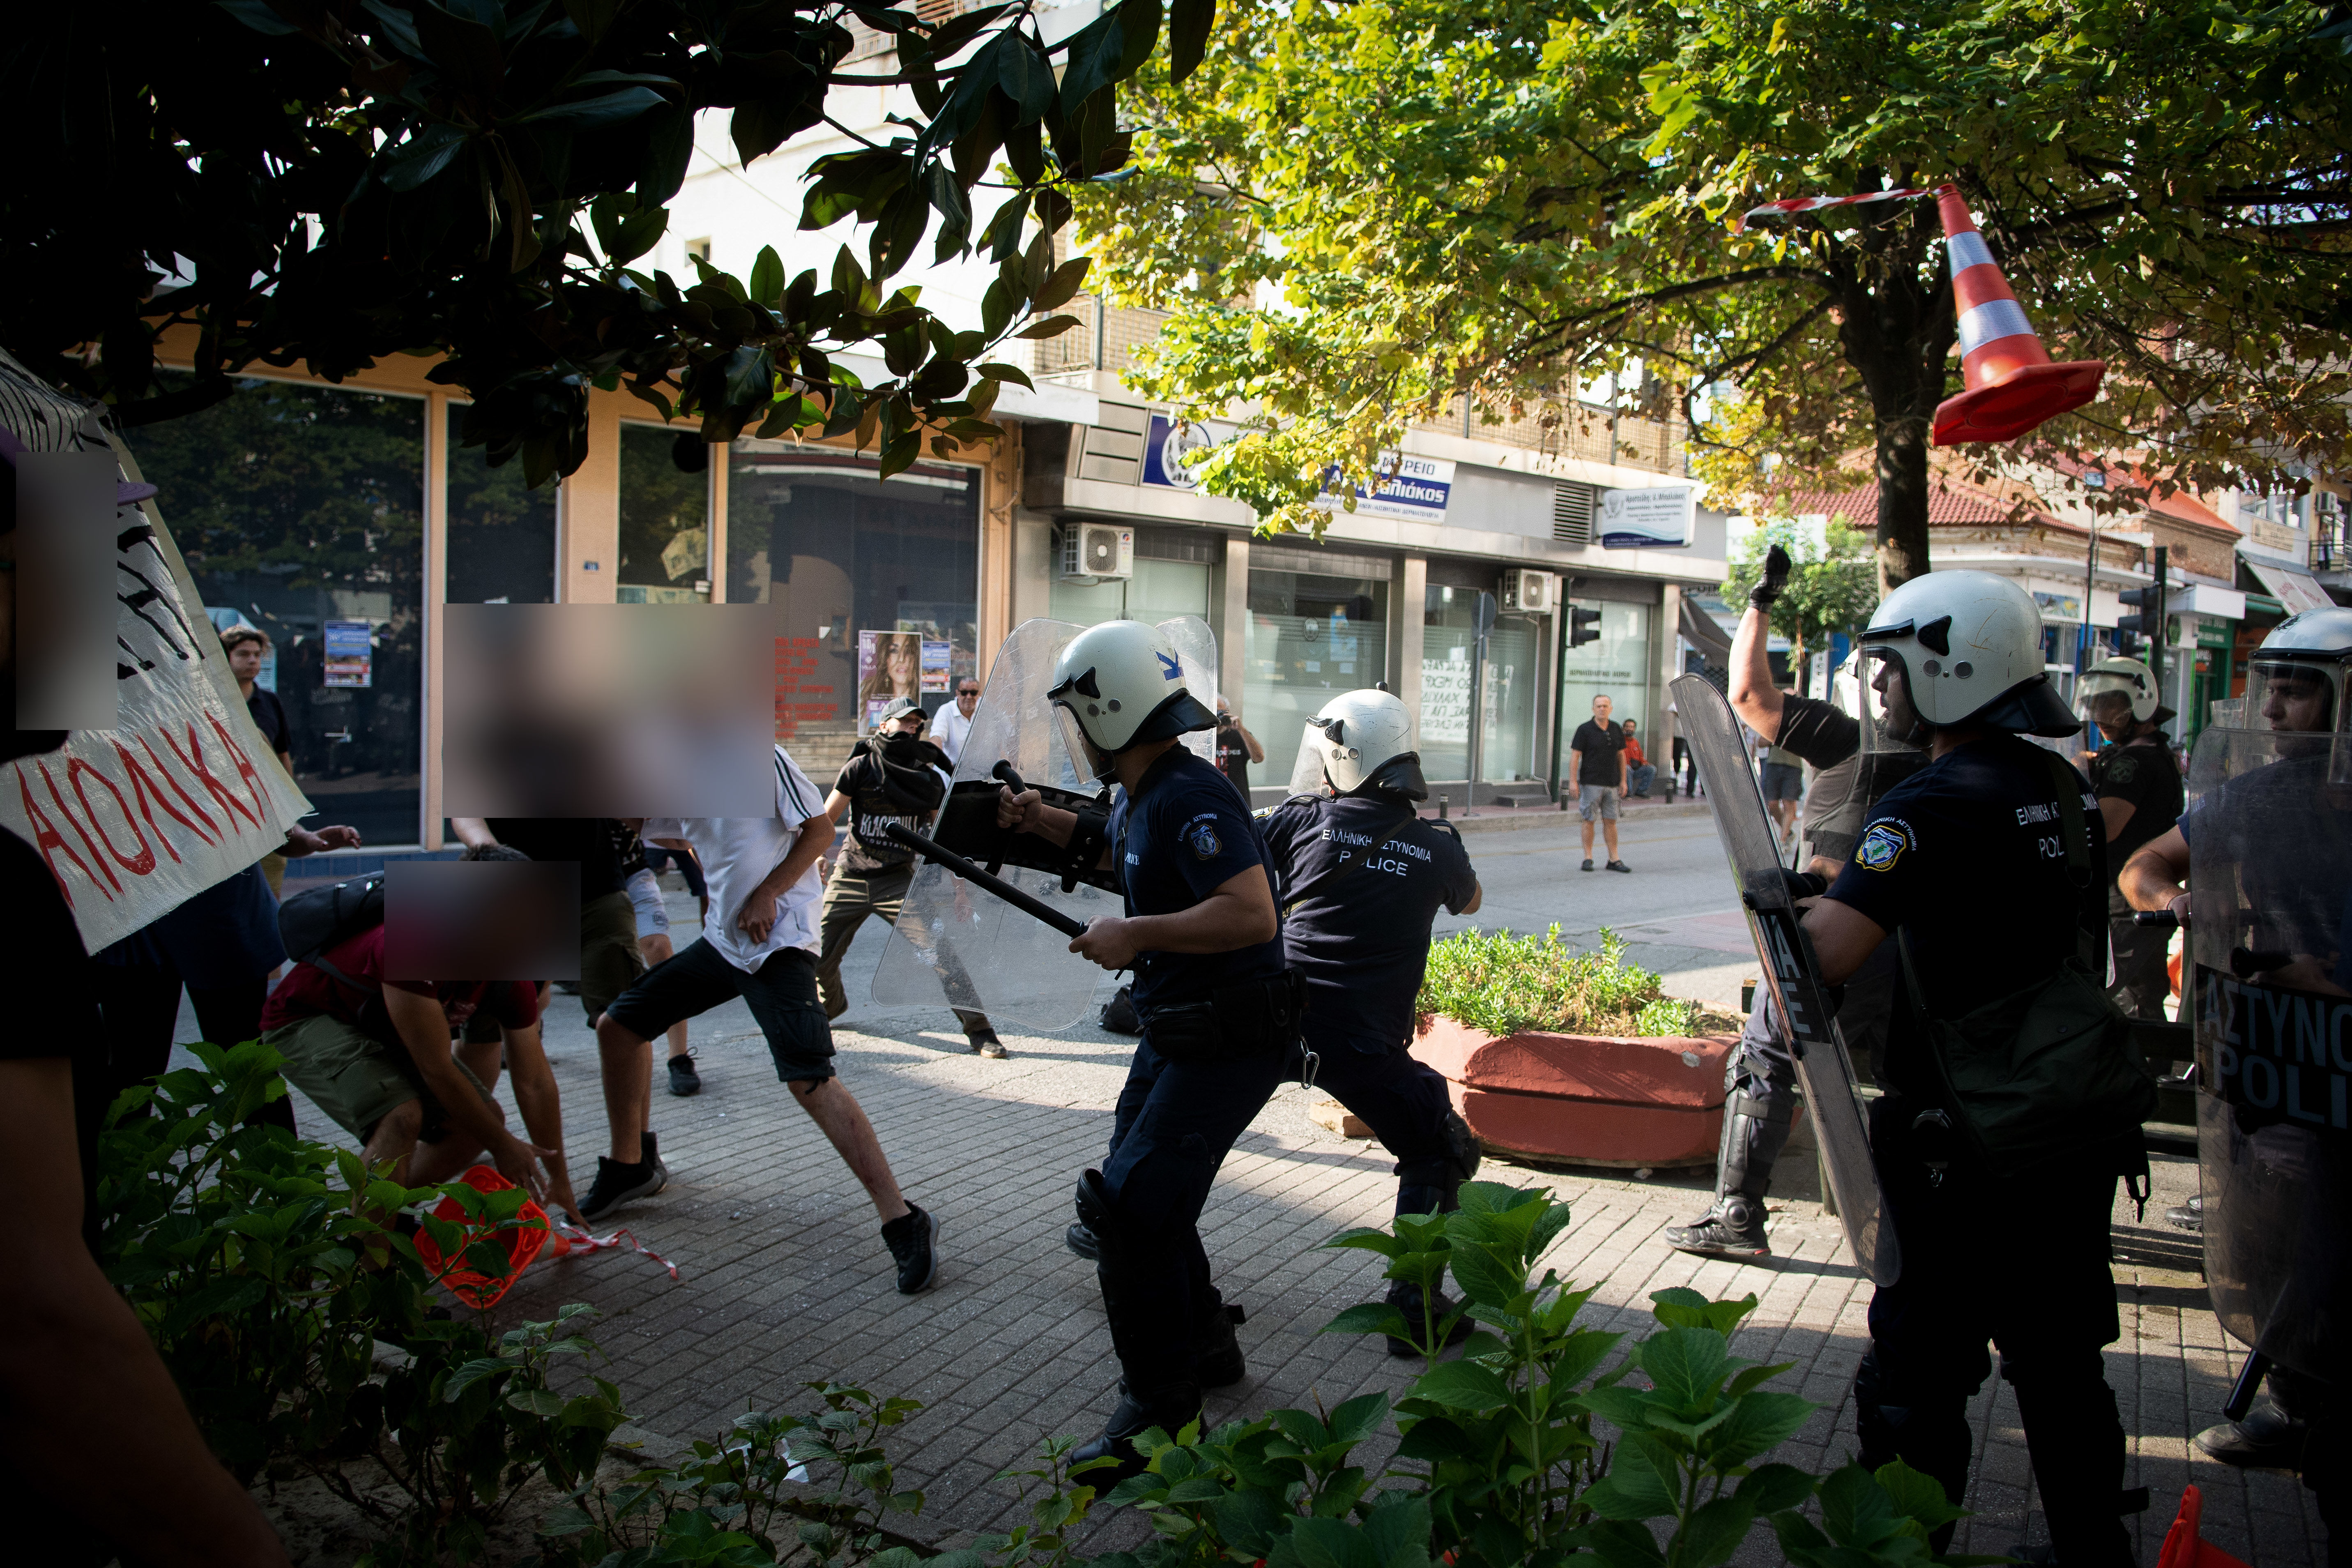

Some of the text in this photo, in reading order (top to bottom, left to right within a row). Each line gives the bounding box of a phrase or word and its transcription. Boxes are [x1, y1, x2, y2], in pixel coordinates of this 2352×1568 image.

[1383, 456, 1436, 475] ΙΑΡΕΙΟ
[14, 709, 276, 912] ΑΙΟΛΙΚΑ
[1178, 813, 1217, 841] ΕΛΛΗΝΙΚΗ ΑΣΤΥΝΟΜΙΑ
[1321, 829, 1373, 847] ΕΛΛΗΝΙΚΗ
[1896, 819, 1917, 851] ΑΣΤΥΝΟΜΙΑ
[1339, 851, 1408, 876] PLICE
